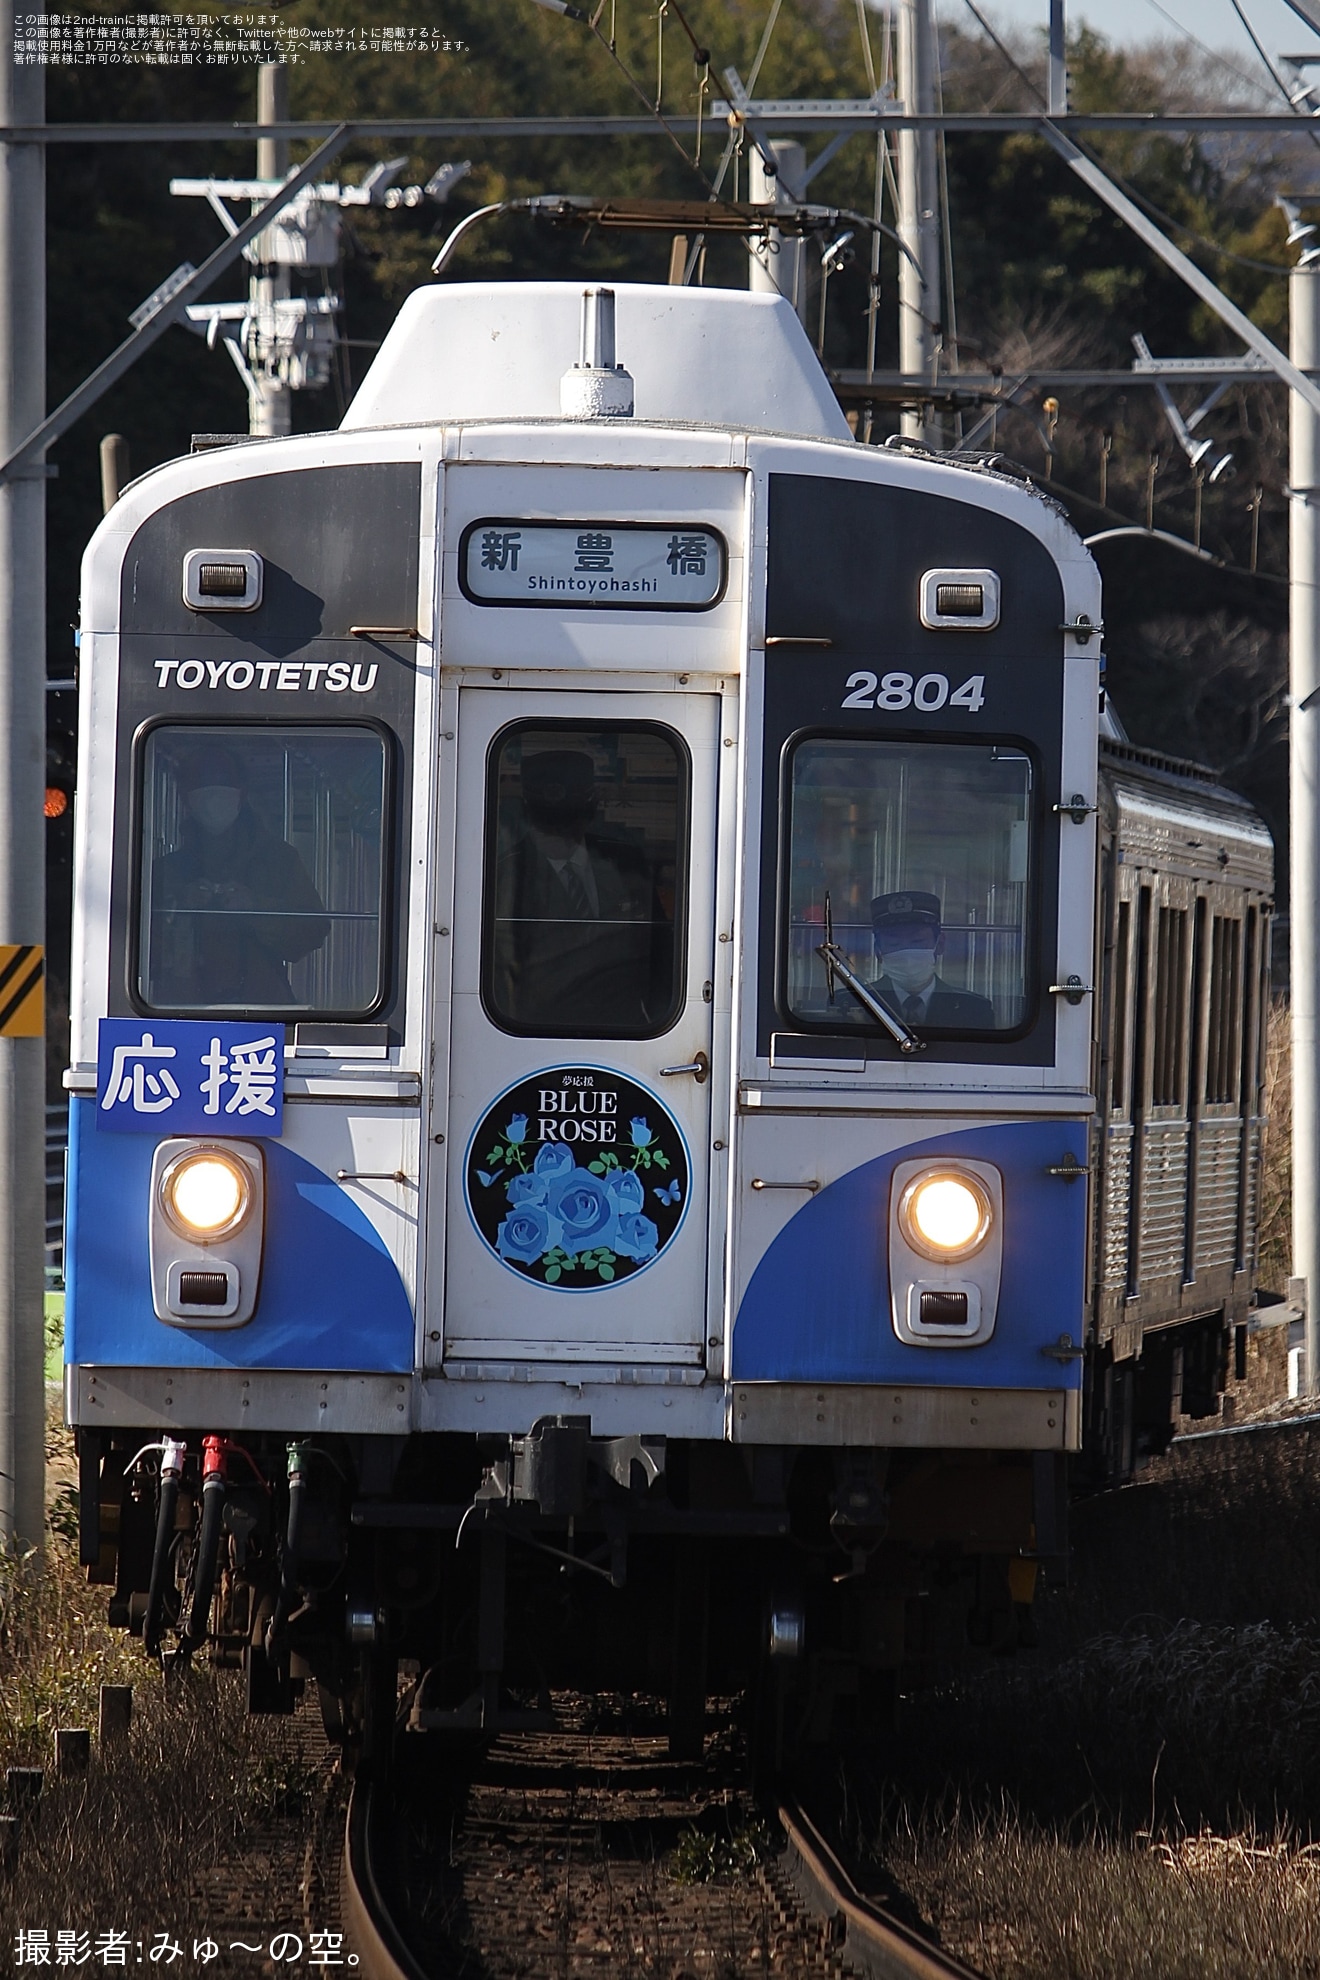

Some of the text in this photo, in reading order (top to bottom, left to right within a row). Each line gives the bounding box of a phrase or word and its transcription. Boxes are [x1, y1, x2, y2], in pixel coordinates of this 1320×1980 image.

[481, 531, 707, 576] 新豊橋
[528, 576, 658, 594] Shintoyohashi
[154, 660, 379, 692] TOYOTETSU
[841, 671, 985, 712] 2804
[101, 1033, 276, 1116] 応援
[562, 1075, 594, 1087] 夢応援
[538, 1090, 618, 1114] BLUE
[537, 1118, 617, 1143] ROSE
